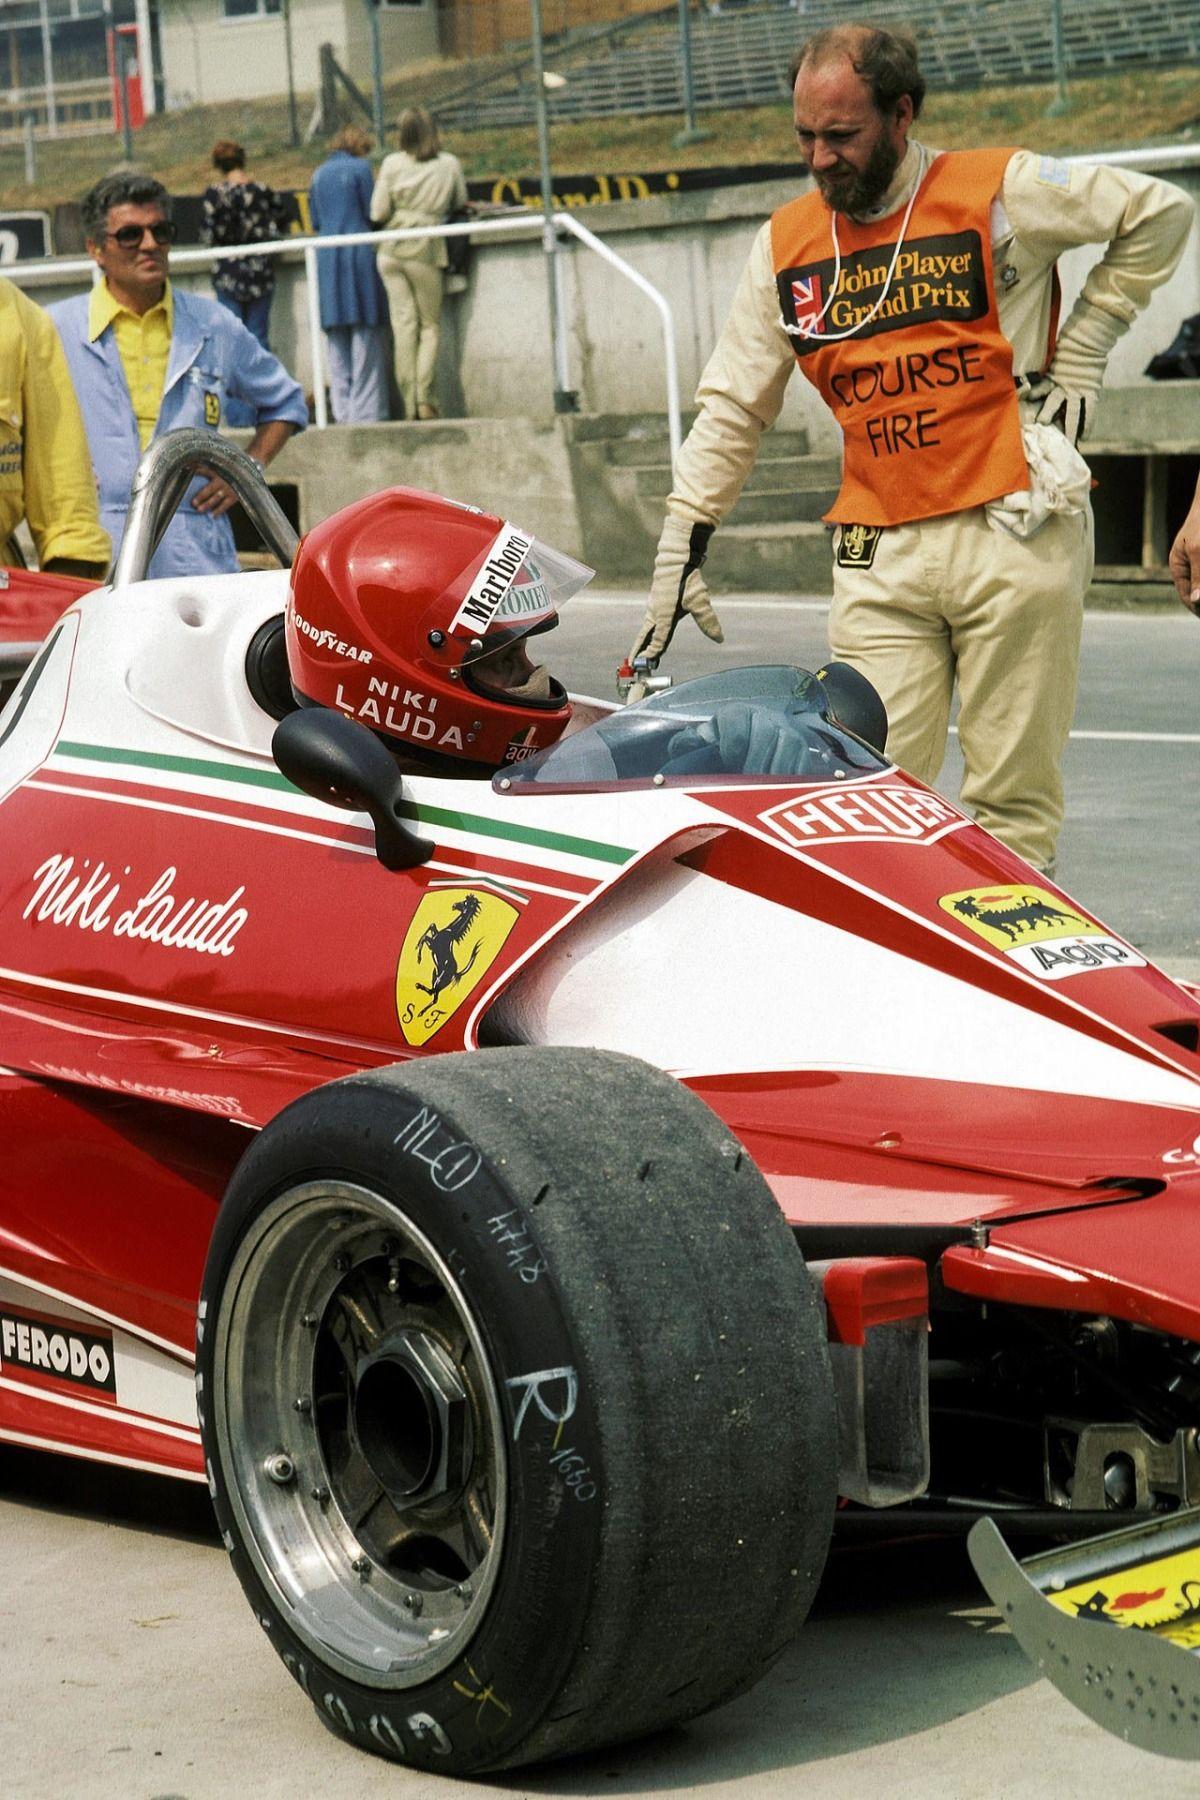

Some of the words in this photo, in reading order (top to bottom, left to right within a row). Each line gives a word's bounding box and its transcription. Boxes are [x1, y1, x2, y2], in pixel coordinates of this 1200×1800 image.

[828, 263, 888, 296] John
[892, 251, 972, 281] Player
[830, 286, 910, 327] Grand
[909, 282, 971, 311] Prix
[830, 343, 985, 408] COURSE
[865, 408, 941, 458] FIRE
[461, 535, 529, 626] Marlboro
[335, 683, 464, 751] LAUDA
[367, 676, 438, 713] NIKI
[781, 789, 958, 838] HEUER
[22, 853, 131, 934] Niki
[113, 866, 249, 957] Lauda
[1030, 938, 1129, 971] Agip
[401, 1002, 416, 1024] S
[1, 1318, 111, 1384] FERODO
[504, 1365, 579, 1442] R
